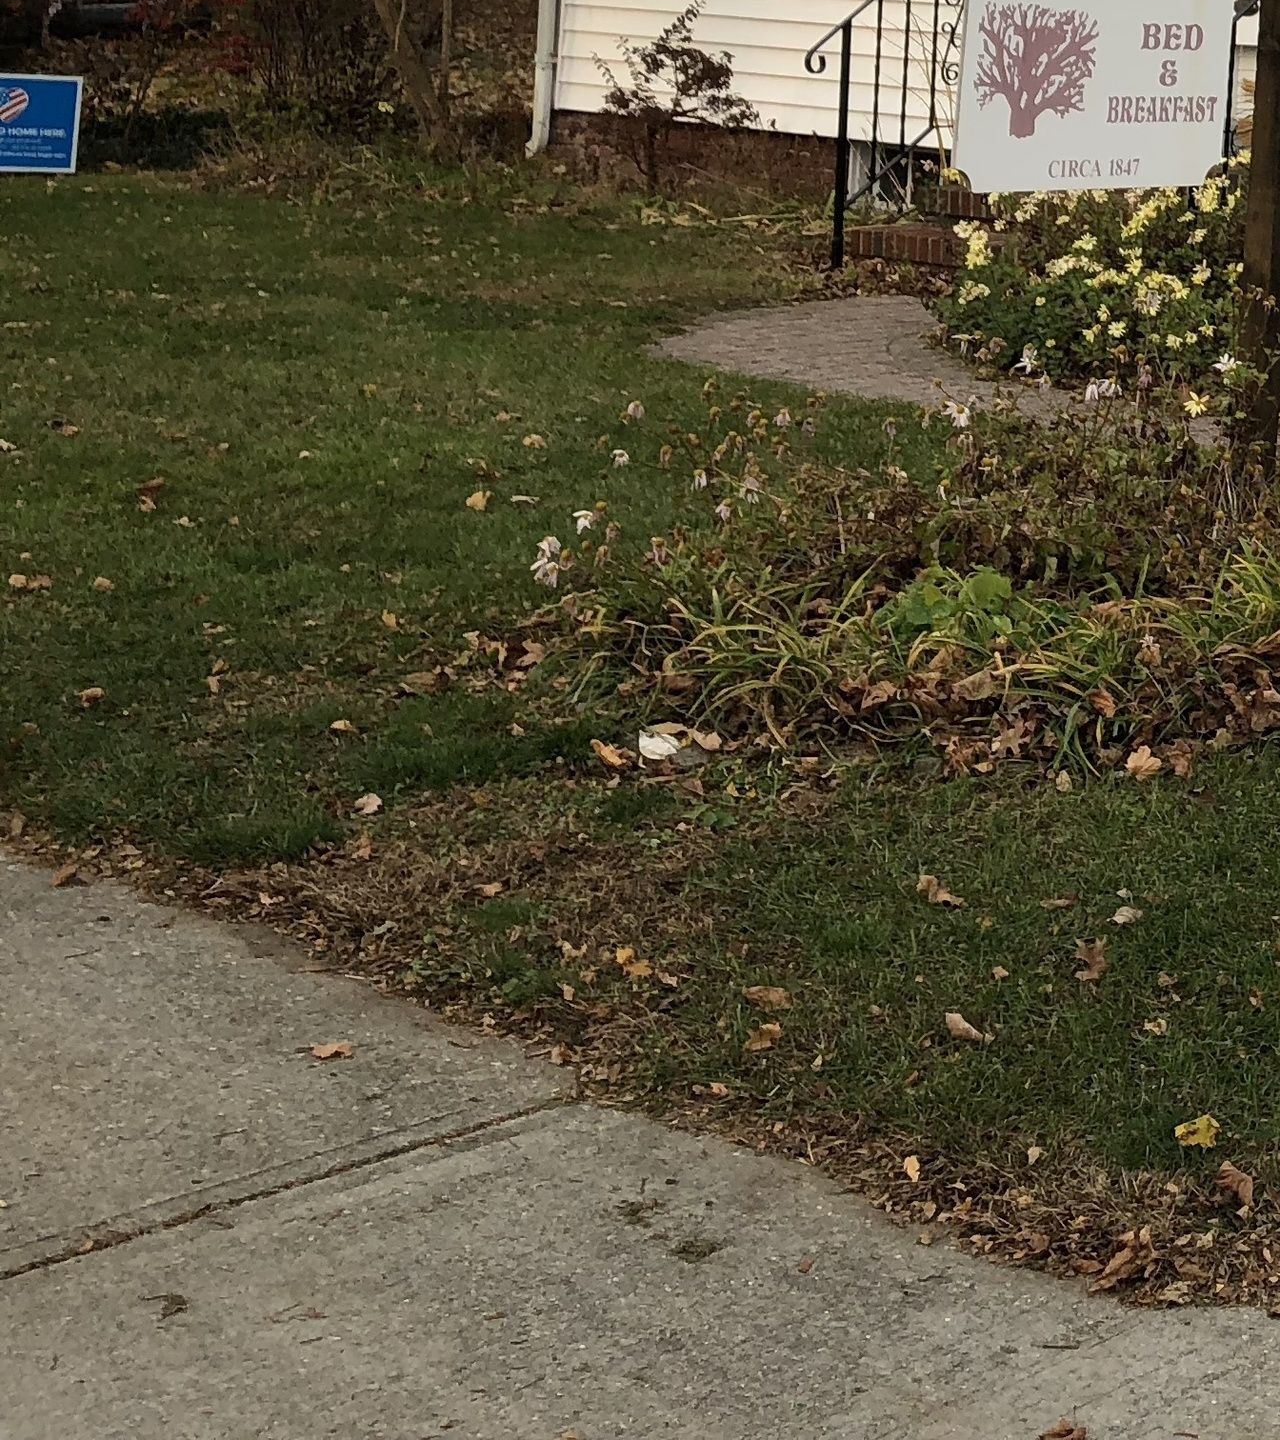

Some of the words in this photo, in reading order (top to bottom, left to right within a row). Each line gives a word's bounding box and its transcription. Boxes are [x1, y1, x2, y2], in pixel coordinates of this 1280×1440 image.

[1140, 22, 1205, 52] BED
[1158, 59, 1178, 88] &
[1105, 94, 1219, 125] BREAKFAST
[1047, 158, 1102, 179] CIRCA
[1108, 157, 1141, 177] 1847
